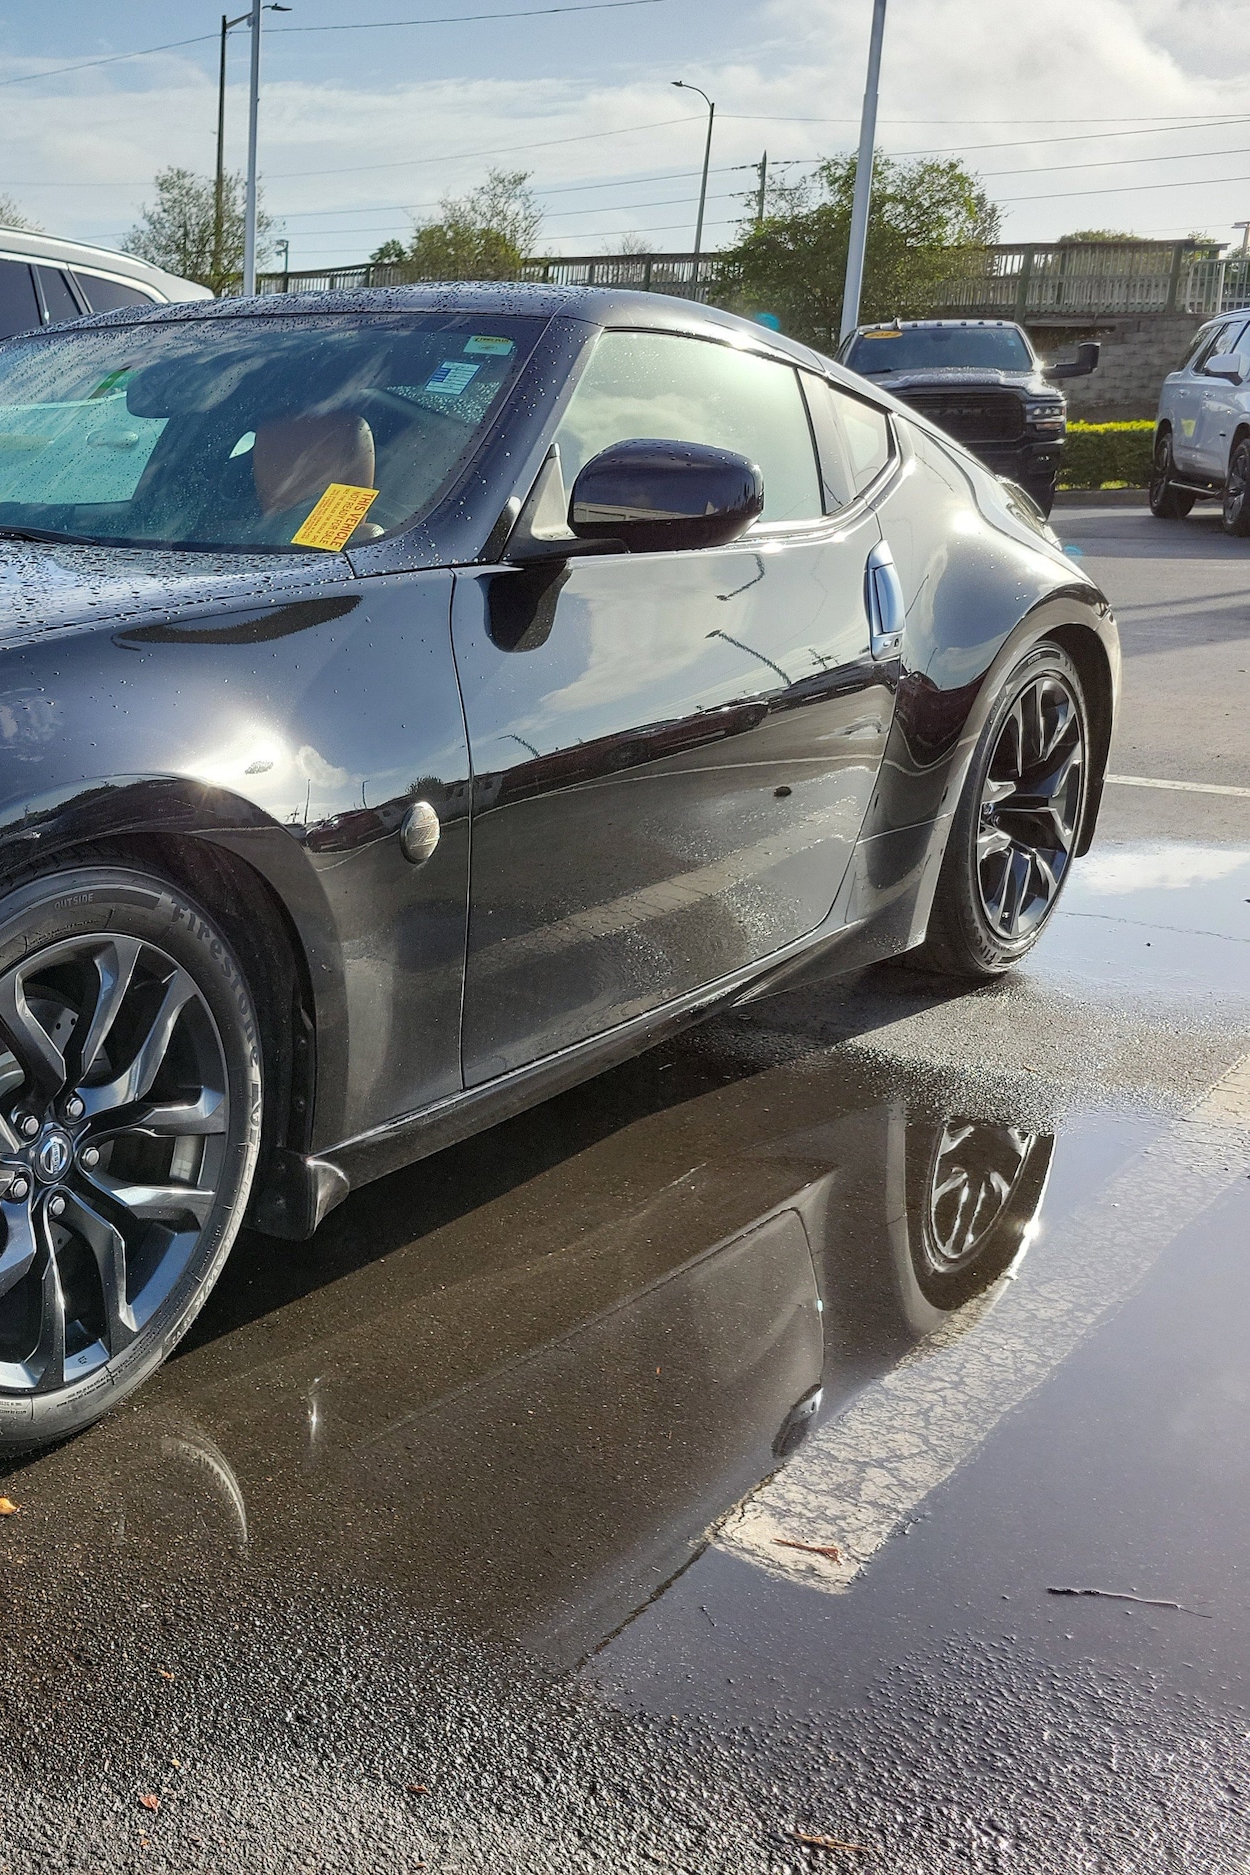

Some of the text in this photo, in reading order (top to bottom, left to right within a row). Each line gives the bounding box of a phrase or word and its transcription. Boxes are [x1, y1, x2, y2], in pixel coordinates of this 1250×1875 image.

[347, 490, 361, 501] NOT
[353, 492, 375, 511] THIS
[335, 501, 354, 518] READY
[328, 519, 342, 530] FOR
[329, 512, 362, 547] VEHICLE
[318, 530, 335, 544] SALE
[53, 890, 95, 914] OUTSIDE
[163, 896, 262, 1069] Firestone
